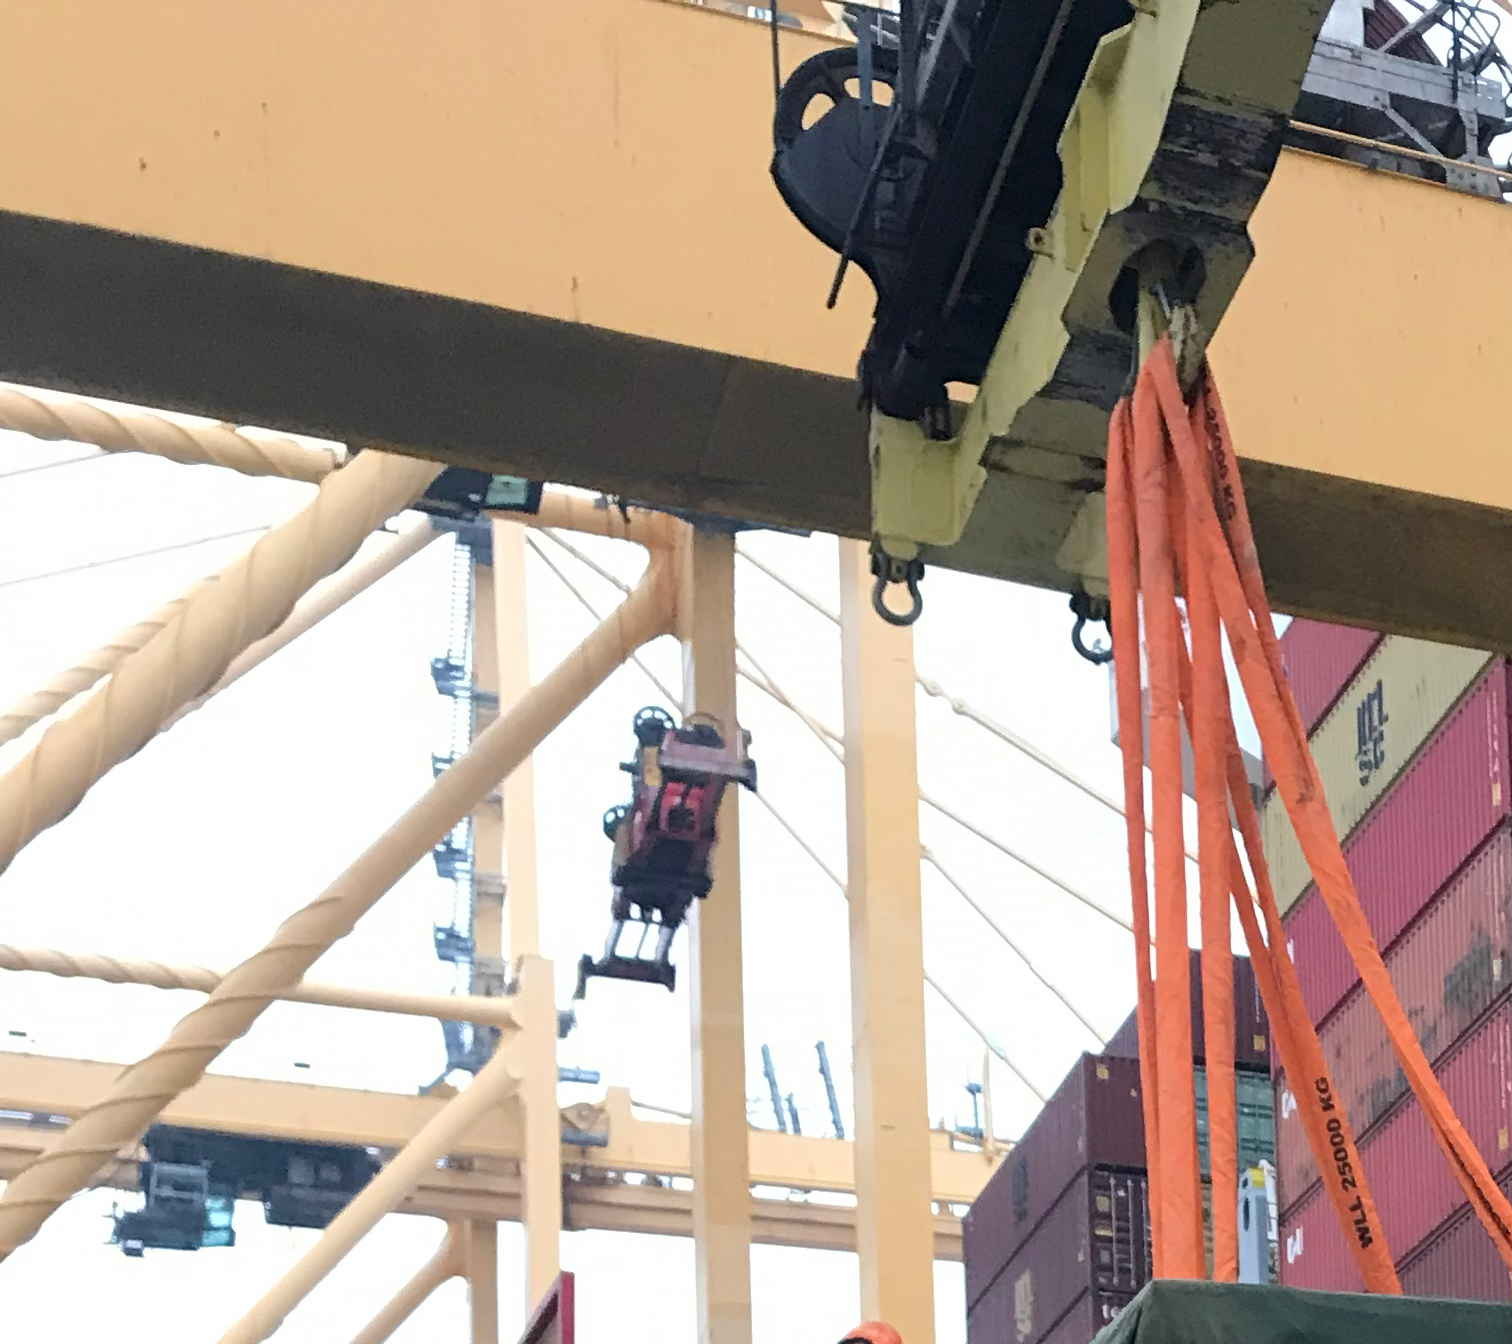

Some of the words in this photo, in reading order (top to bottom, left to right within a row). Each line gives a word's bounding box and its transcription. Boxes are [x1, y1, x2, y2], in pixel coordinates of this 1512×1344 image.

[1314, 1076, 1336, 1112] KG
[1326, 1118, 1358, 1193] 25000
[1348, 1195, 1374, 1249] WLL
